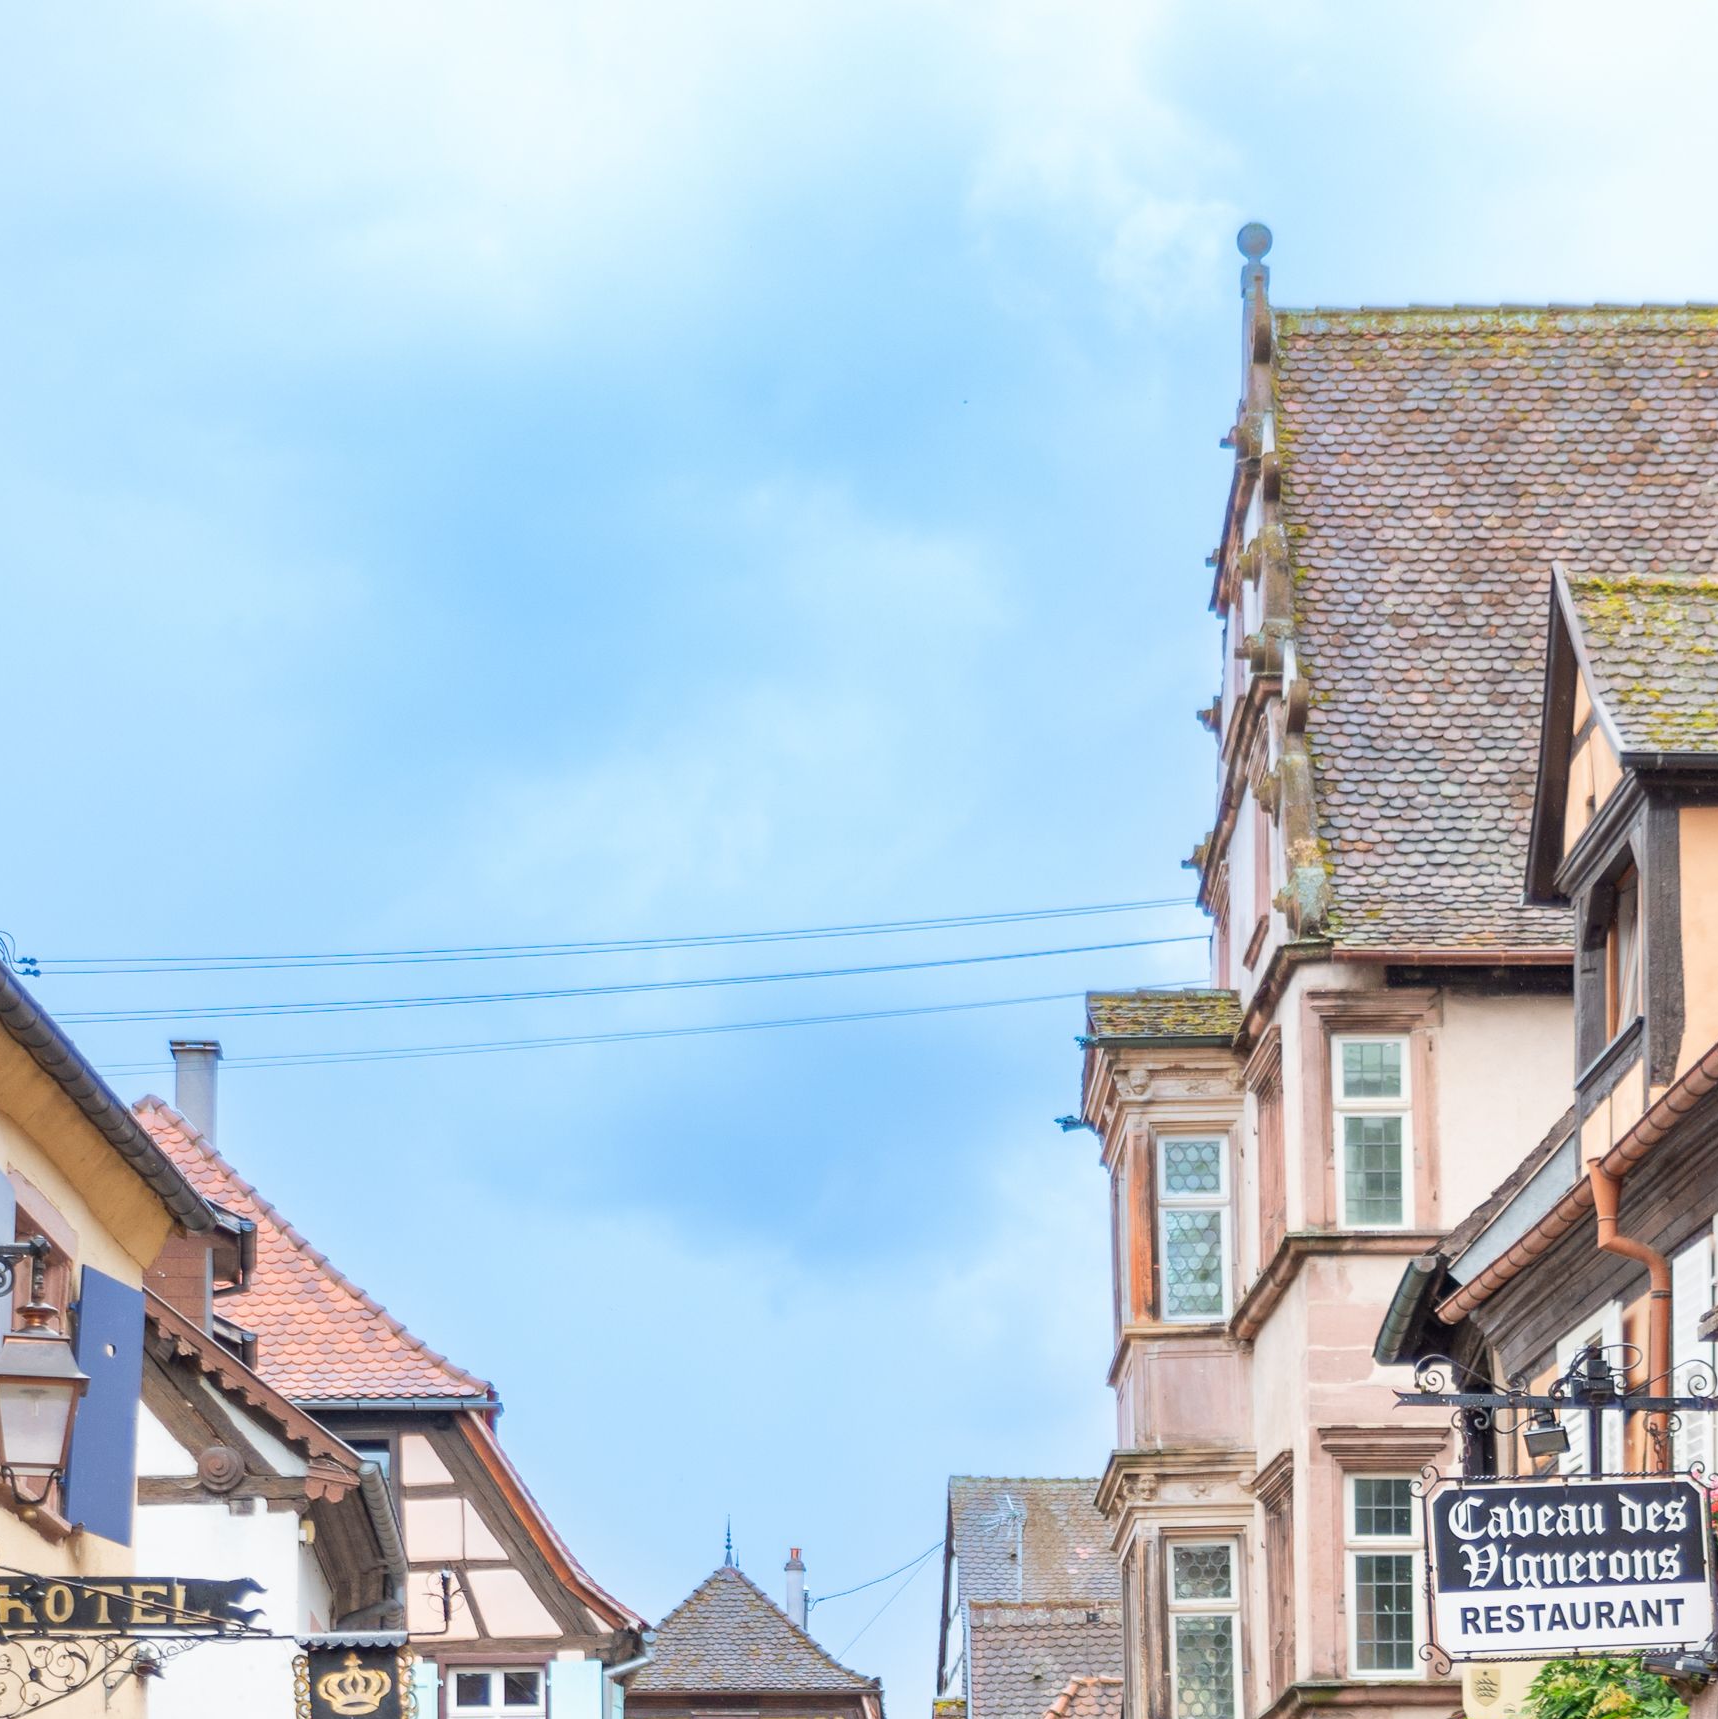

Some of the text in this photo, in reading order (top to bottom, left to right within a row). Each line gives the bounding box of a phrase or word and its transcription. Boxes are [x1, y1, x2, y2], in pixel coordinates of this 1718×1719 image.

[1448, 1493, 1688, 1541] Caveau des
[1459, 1543, 1682, 1591] Vignerons
[1460, 1597, 1685, 1636] RESTAURANT
